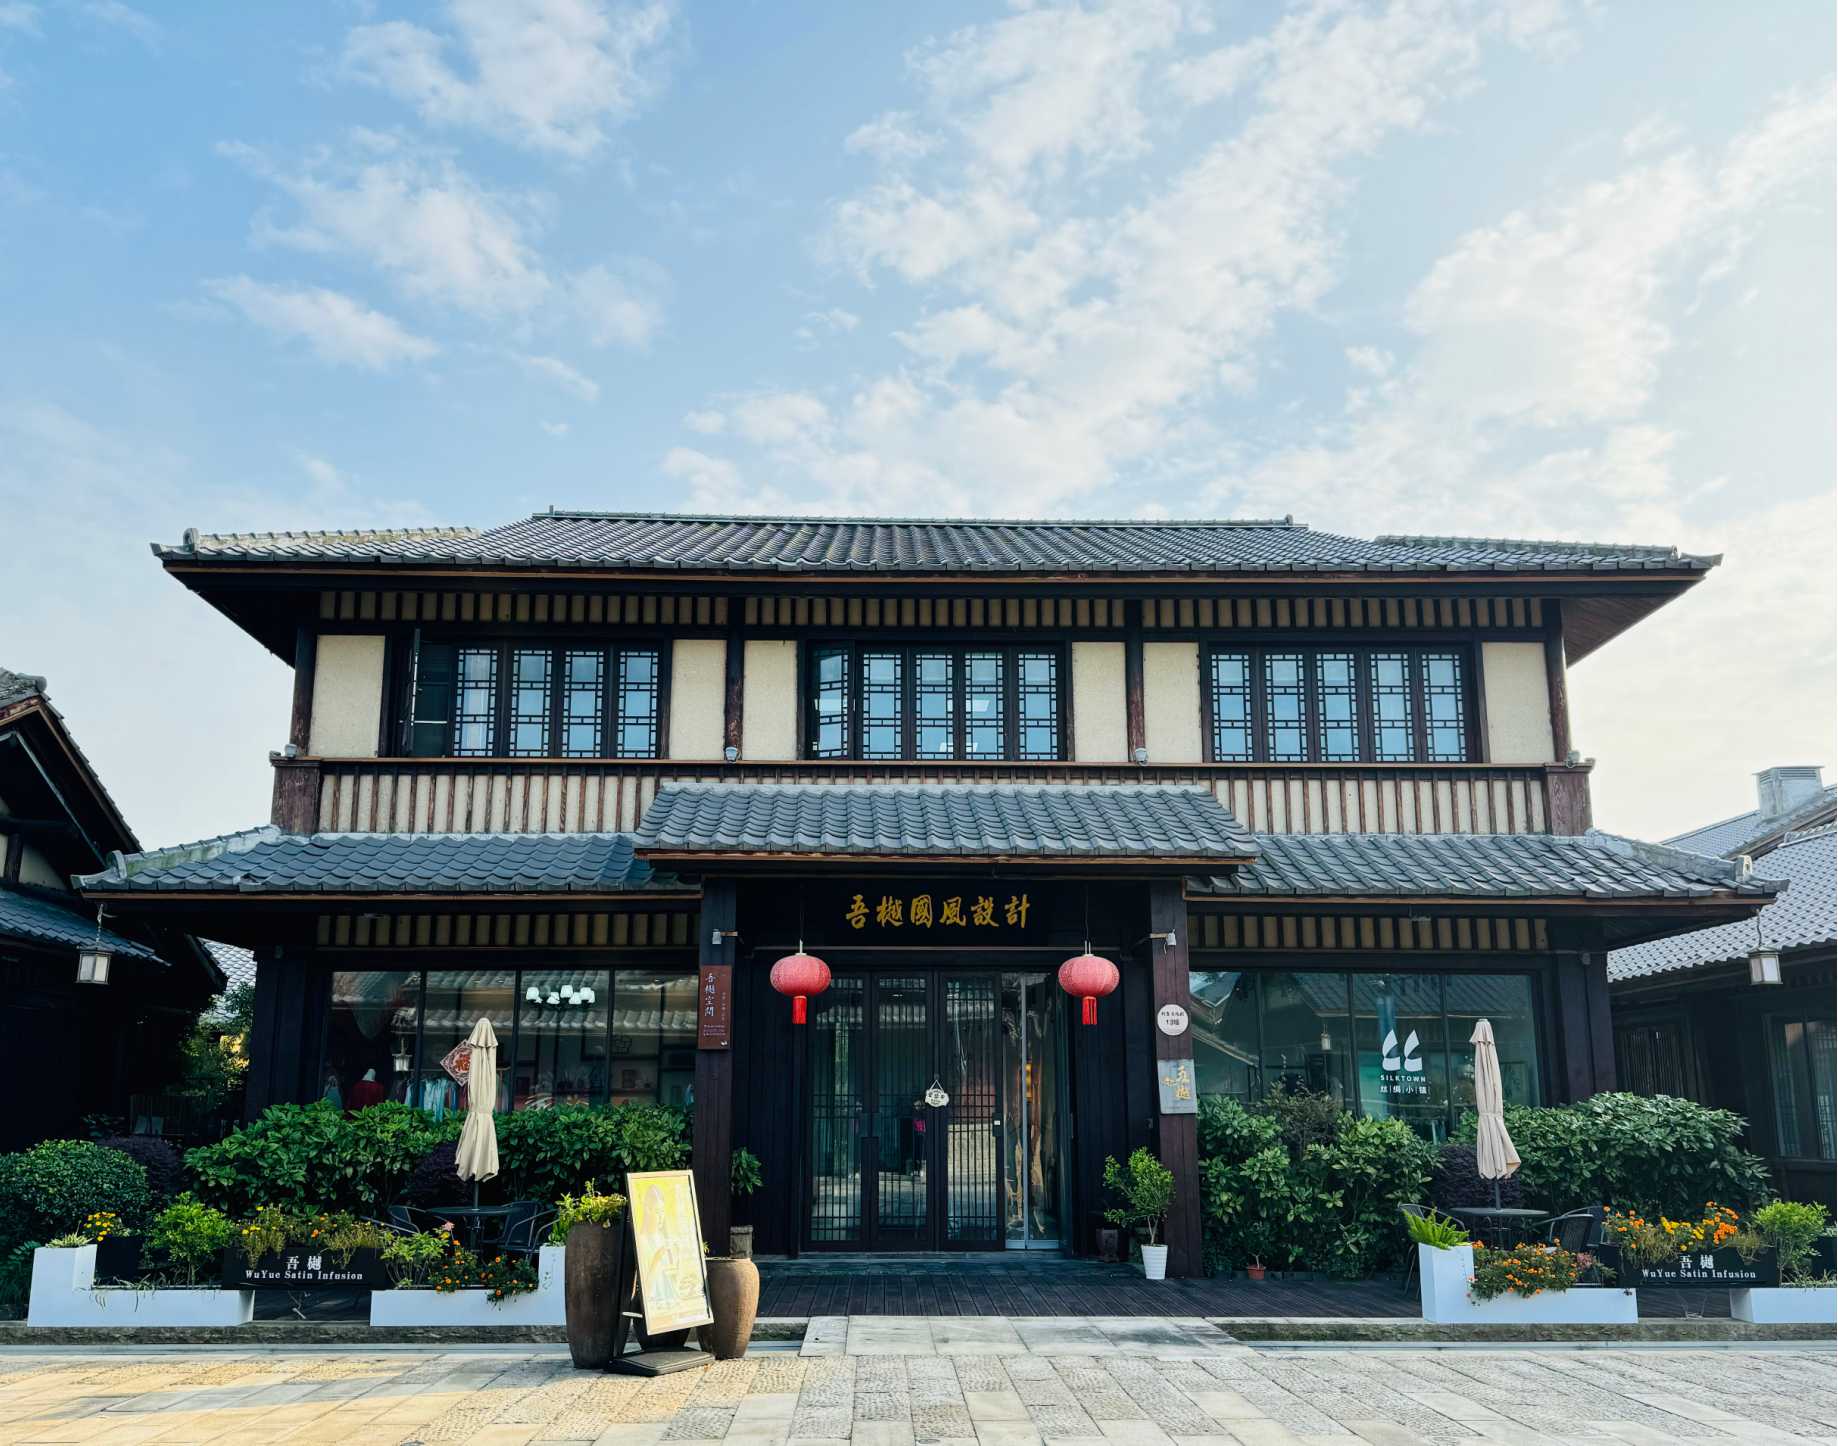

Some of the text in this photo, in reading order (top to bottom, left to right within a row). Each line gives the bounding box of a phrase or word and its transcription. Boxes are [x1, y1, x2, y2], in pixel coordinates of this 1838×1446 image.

[1380, 1074, 1426, 1083] SILKTOWN
[245, 1269, 363, 1280] WuYue Satin Infusion
[1642, 1268, 1756, 1278] WuYue Satin Infusion
